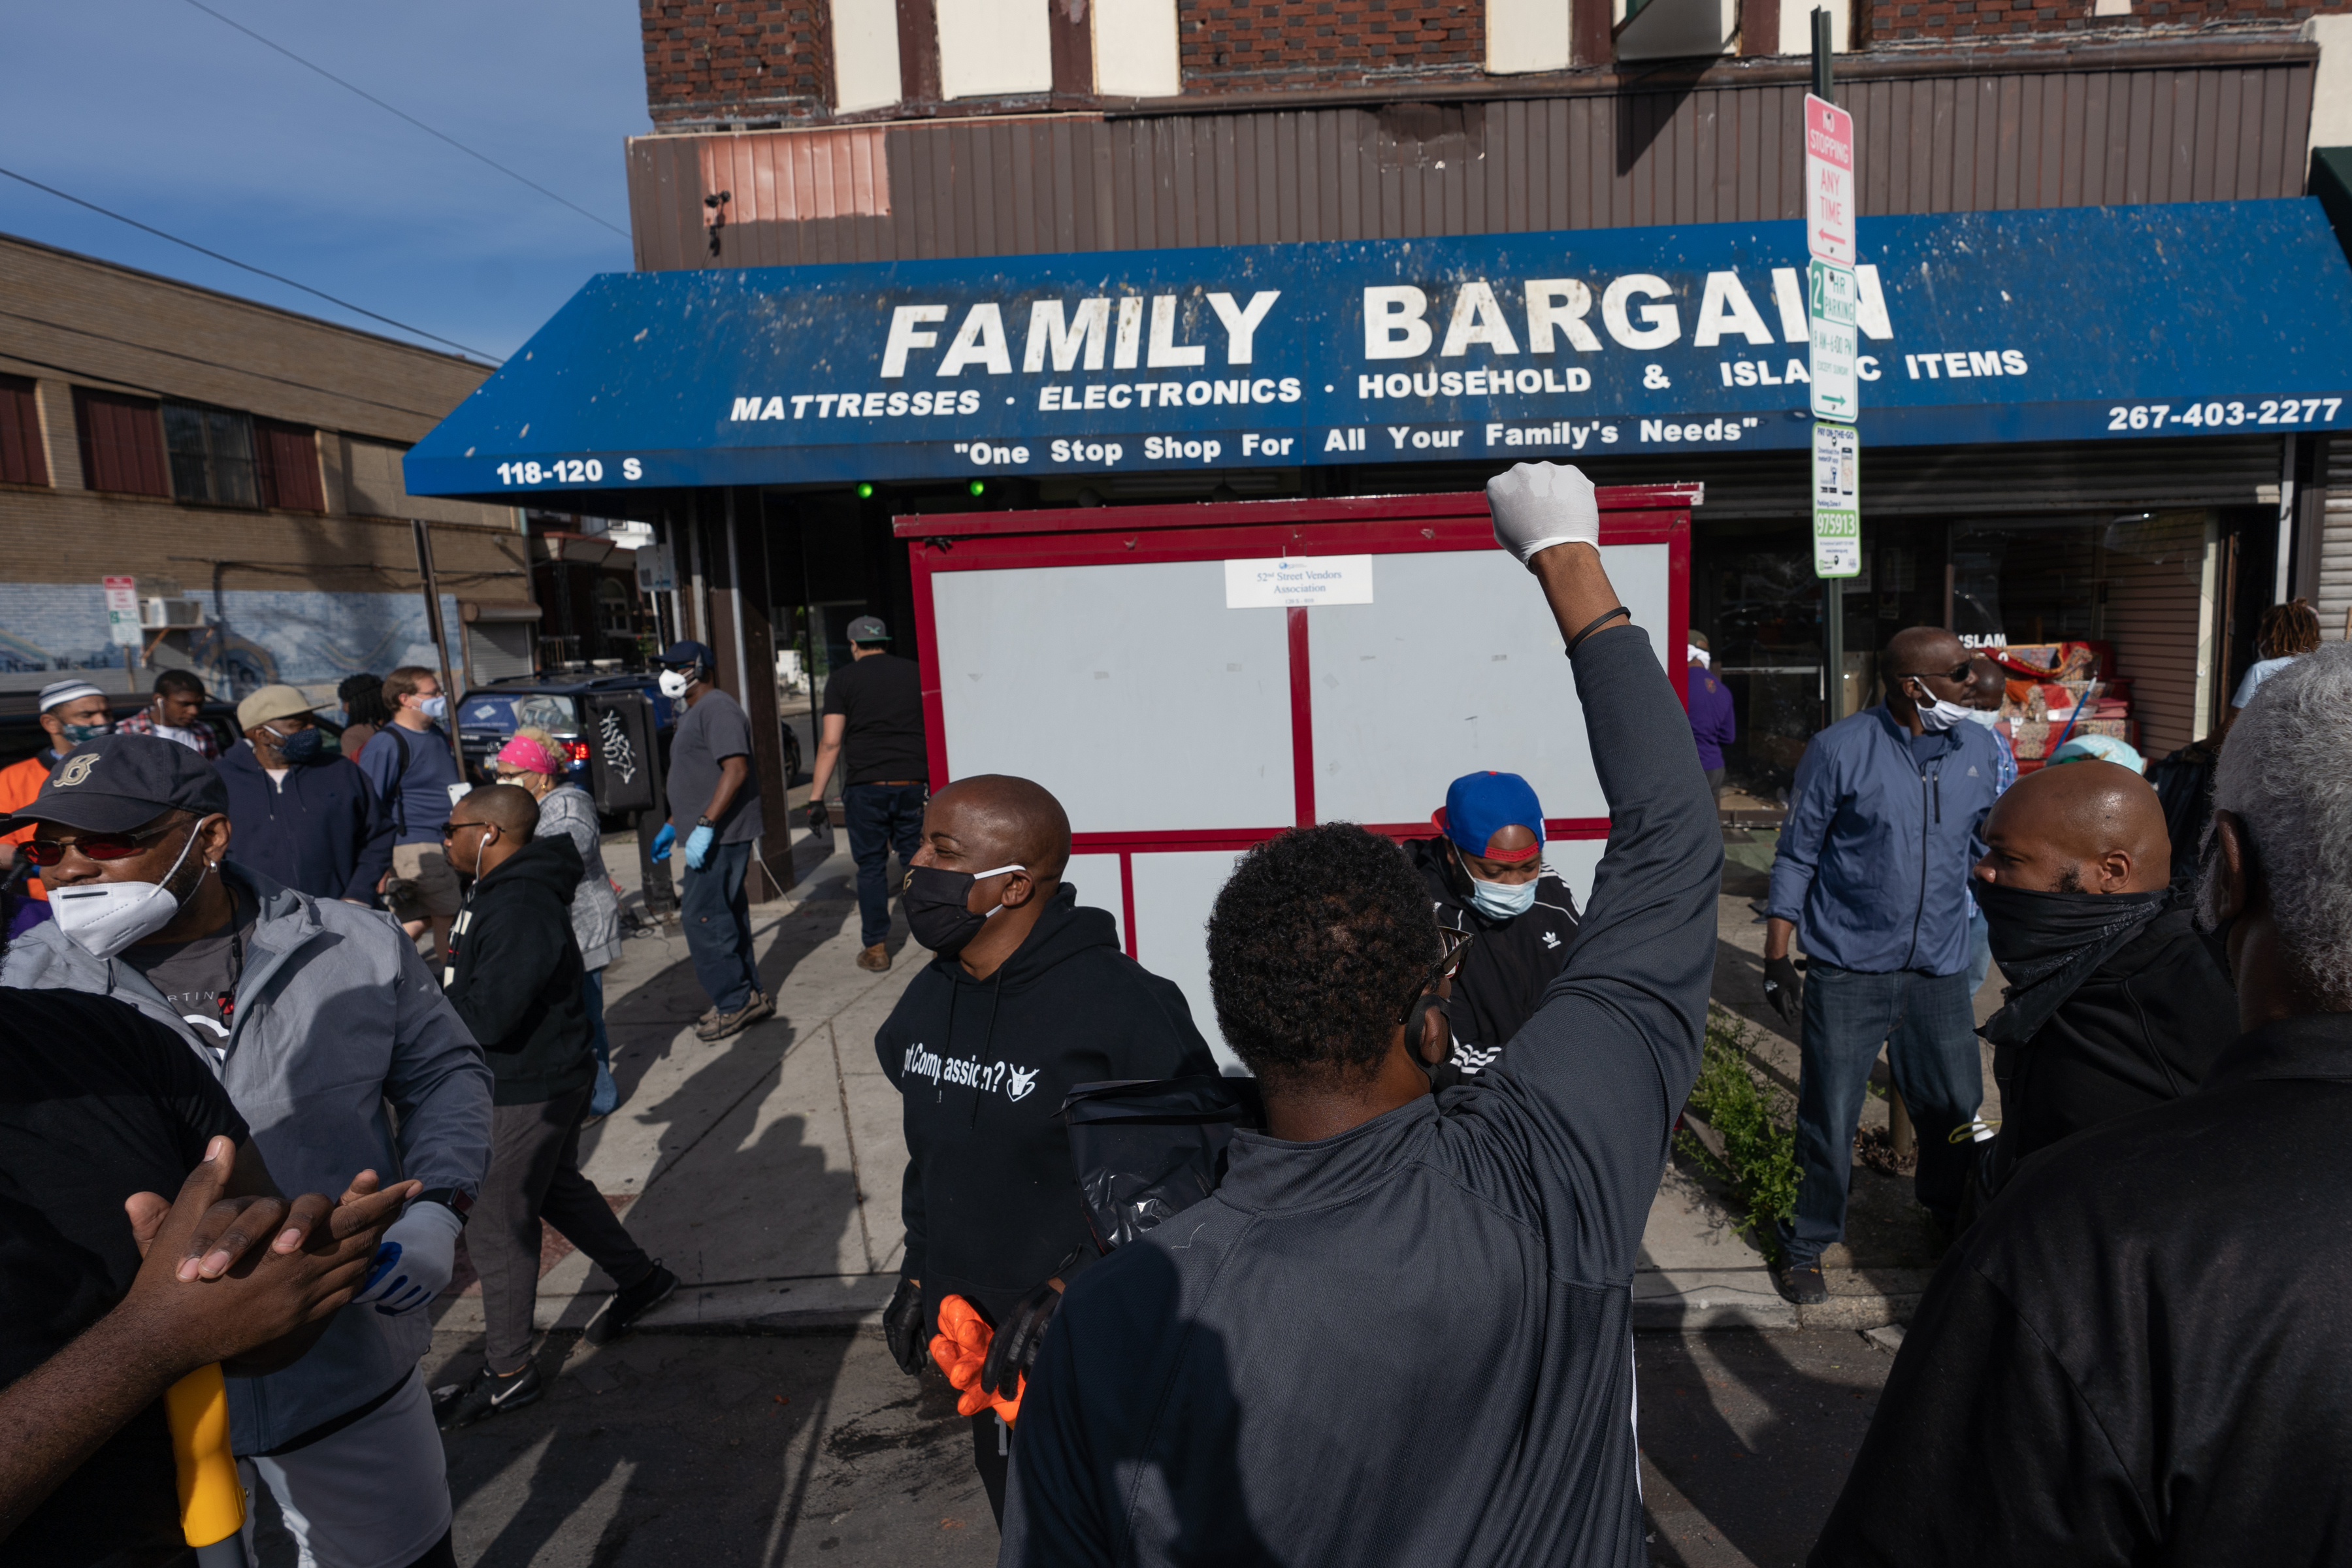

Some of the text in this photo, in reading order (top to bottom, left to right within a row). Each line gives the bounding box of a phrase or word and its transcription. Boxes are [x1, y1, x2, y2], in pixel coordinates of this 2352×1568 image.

[1822, 109, 1835, 133] NO
[1810, 129, 1849, 164] STOPPING
[1820, 167, 1840, 197] ANY
[1820, 195, 1842, 226] TIME
[1813, 270, 1846, 310] 2 HR
[1824, 296, 1854, 321] PARKING
[880, 291, 1282, 378] FAMILY
[1844, 338, 1853, 355] PM
[1817, 360, 1849, 376] EXCEPT SUNDAY
[730, 350, 2029, 421] MATTRESSES ELECTRONICS HOUSEHOLD & ISLAC ITEMS
[2108, 397, 2342, 431] 267-403-2277
[954, 417, 1758, 466] "One Stop Shop For All Your Family's Needs"
[497, 457, 643, 485] 118-120 S
[1817, 513, 1856, 535] 975913
[1273, 583, 1326, 594] Association
[1277, 571, 1303, 581] Street
[1305, 570, 1342, 580] Vendors
